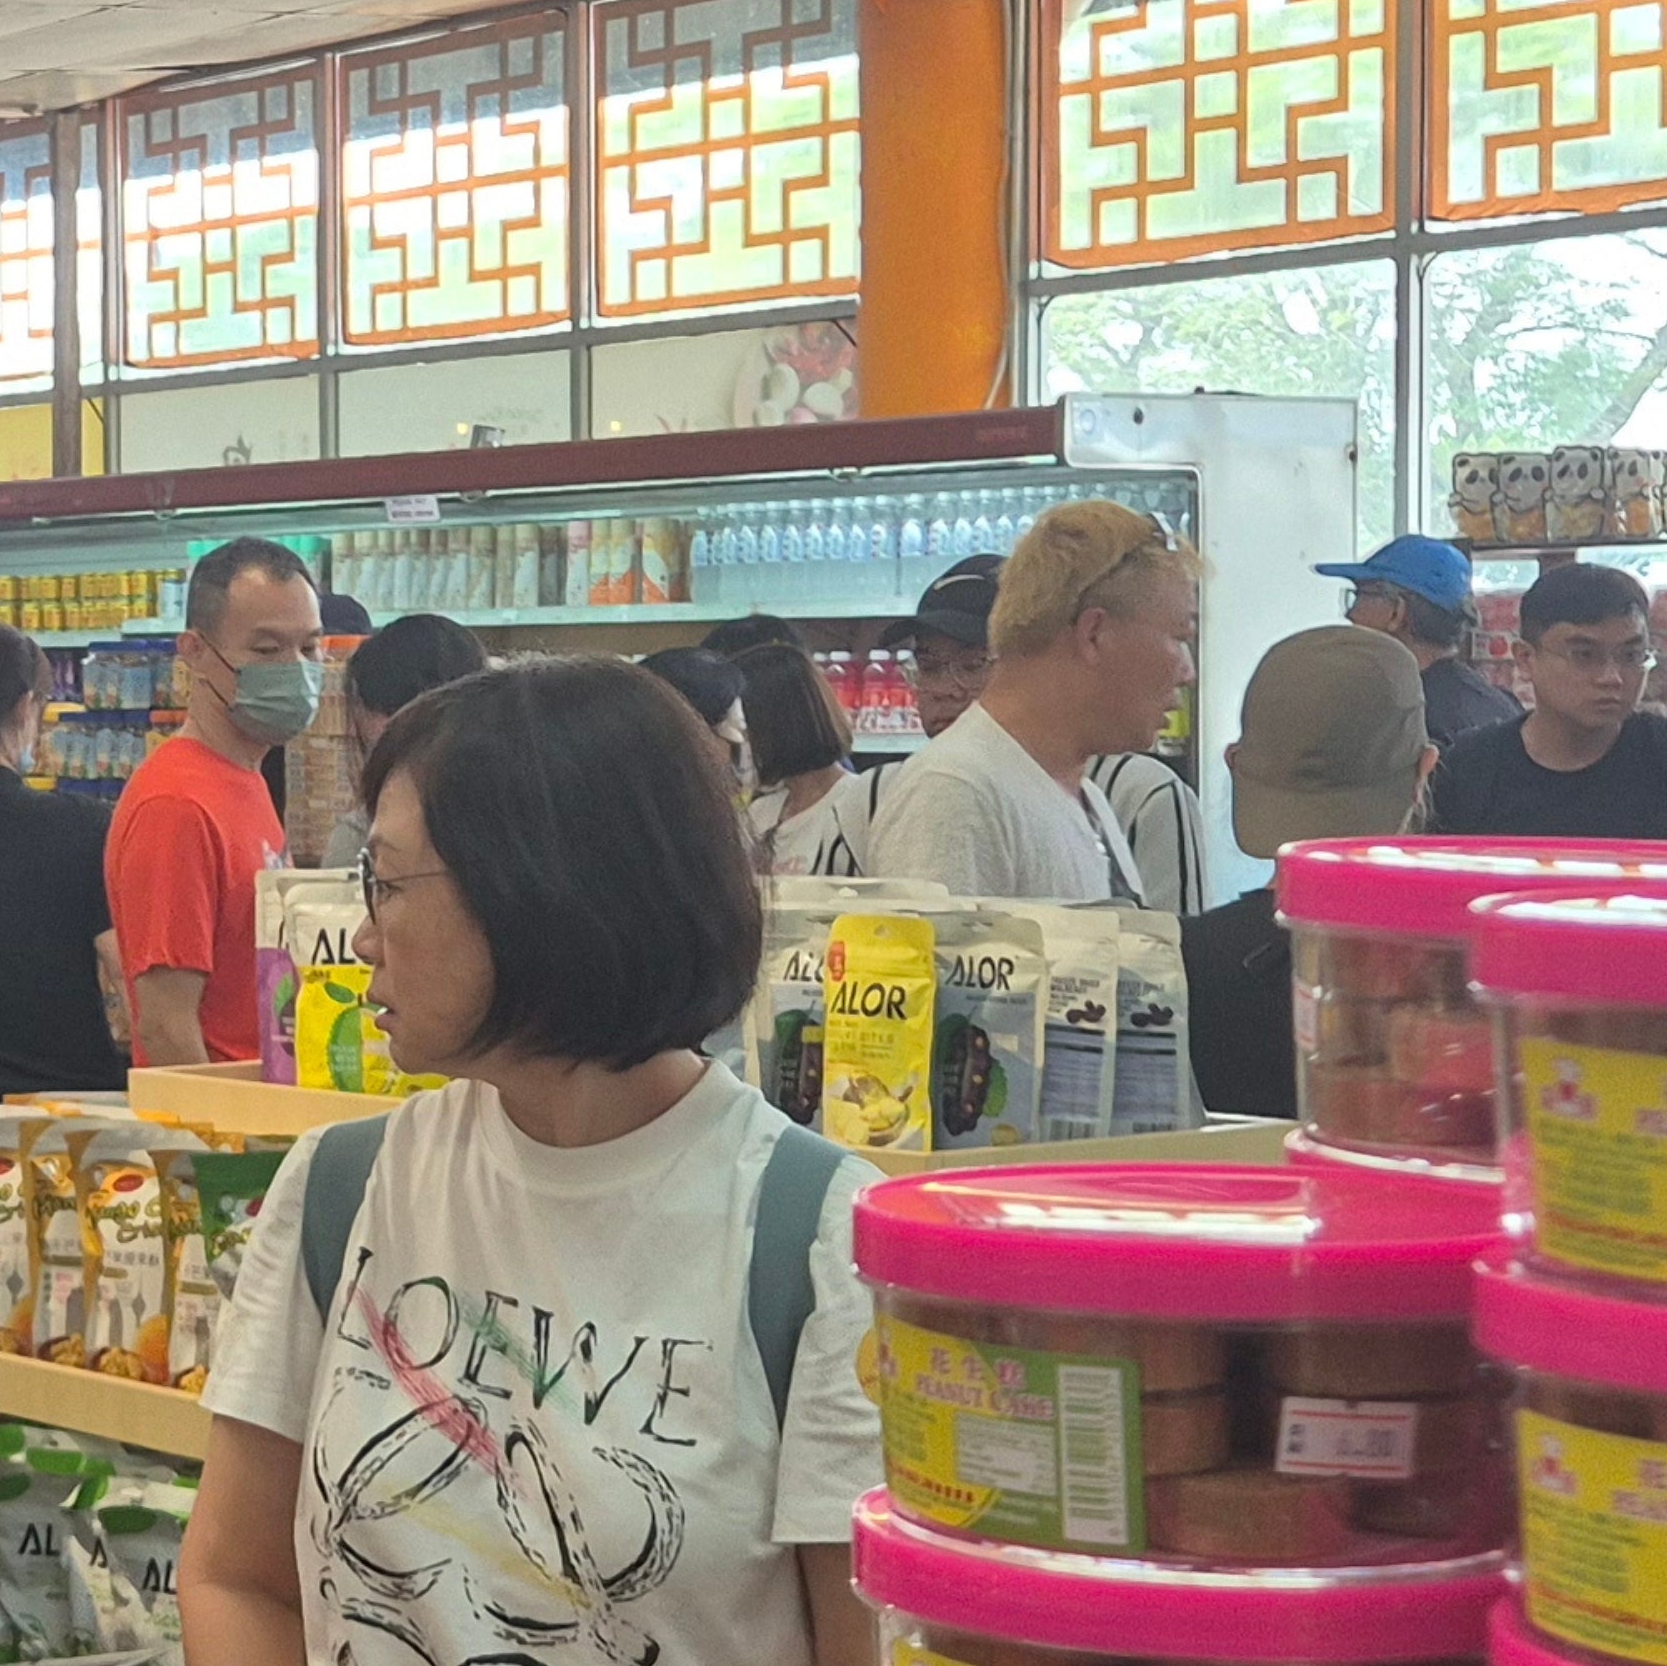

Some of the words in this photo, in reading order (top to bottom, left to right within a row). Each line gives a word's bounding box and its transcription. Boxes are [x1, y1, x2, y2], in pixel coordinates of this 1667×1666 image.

[312, 928, 357, 965] AL
[946, 955, 1017, 991] ALOR
[831, 981, 908, 1020] ALOR
[338, 1246, 713, 1446] LOEWE
[19, 1522, 61, 1556] AL
[144, 1557, 177, 1595] AL
